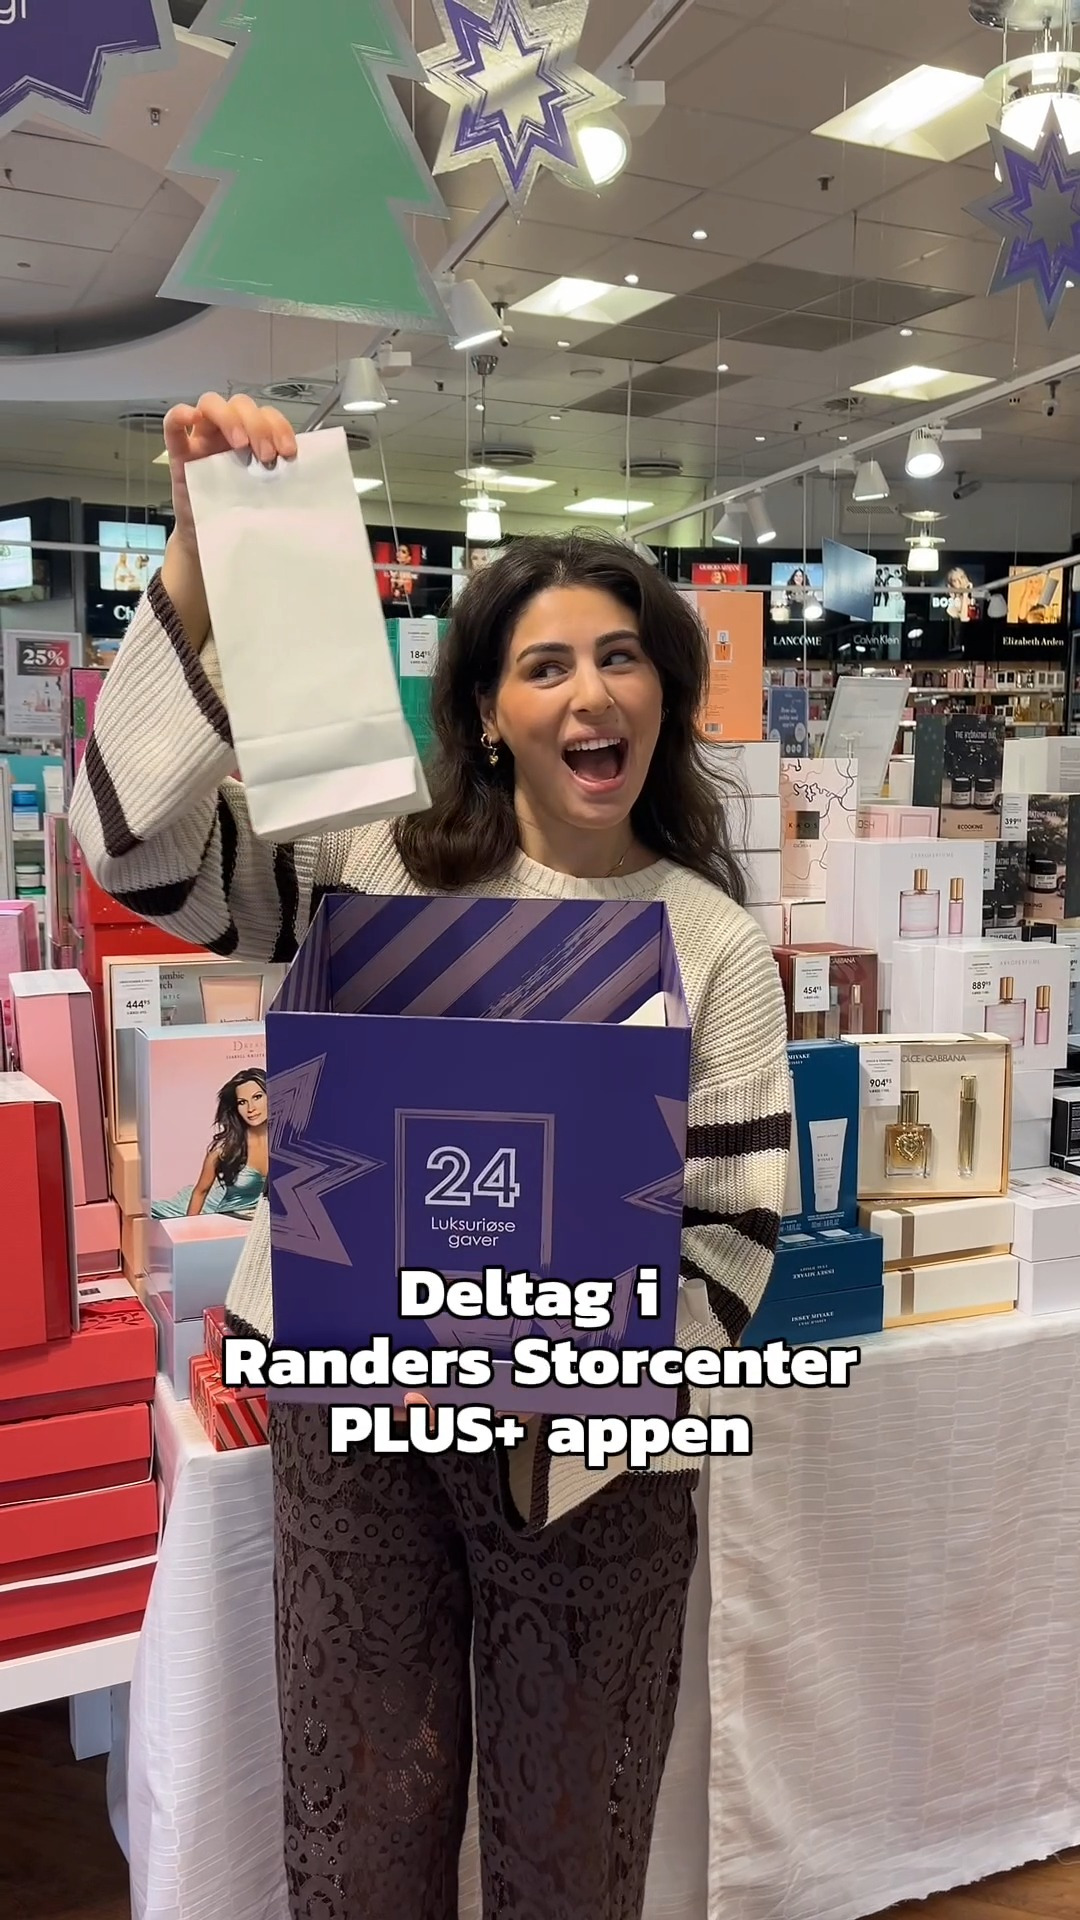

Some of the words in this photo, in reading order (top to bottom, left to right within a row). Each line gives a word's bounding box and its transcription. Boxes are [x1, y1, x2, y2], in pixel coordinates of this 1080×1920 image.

[853, 634, 879, 645] Calvin
[880, 634, 900, 645] Klein
[1002, 636, 1040, 646] Elizabeth
[1041, 636, 1064, 646] Arden
[22, 648, 65, 666] 25%
[957, 823, 983, 831] ECOOKING
[926, 1054, 966, 1062] GABBANA
[425, 1146, 520, 1208] 24
[431, 1216, 516, 1232] Luksuriøse
[448, 1234, 499, 1249] gaver
